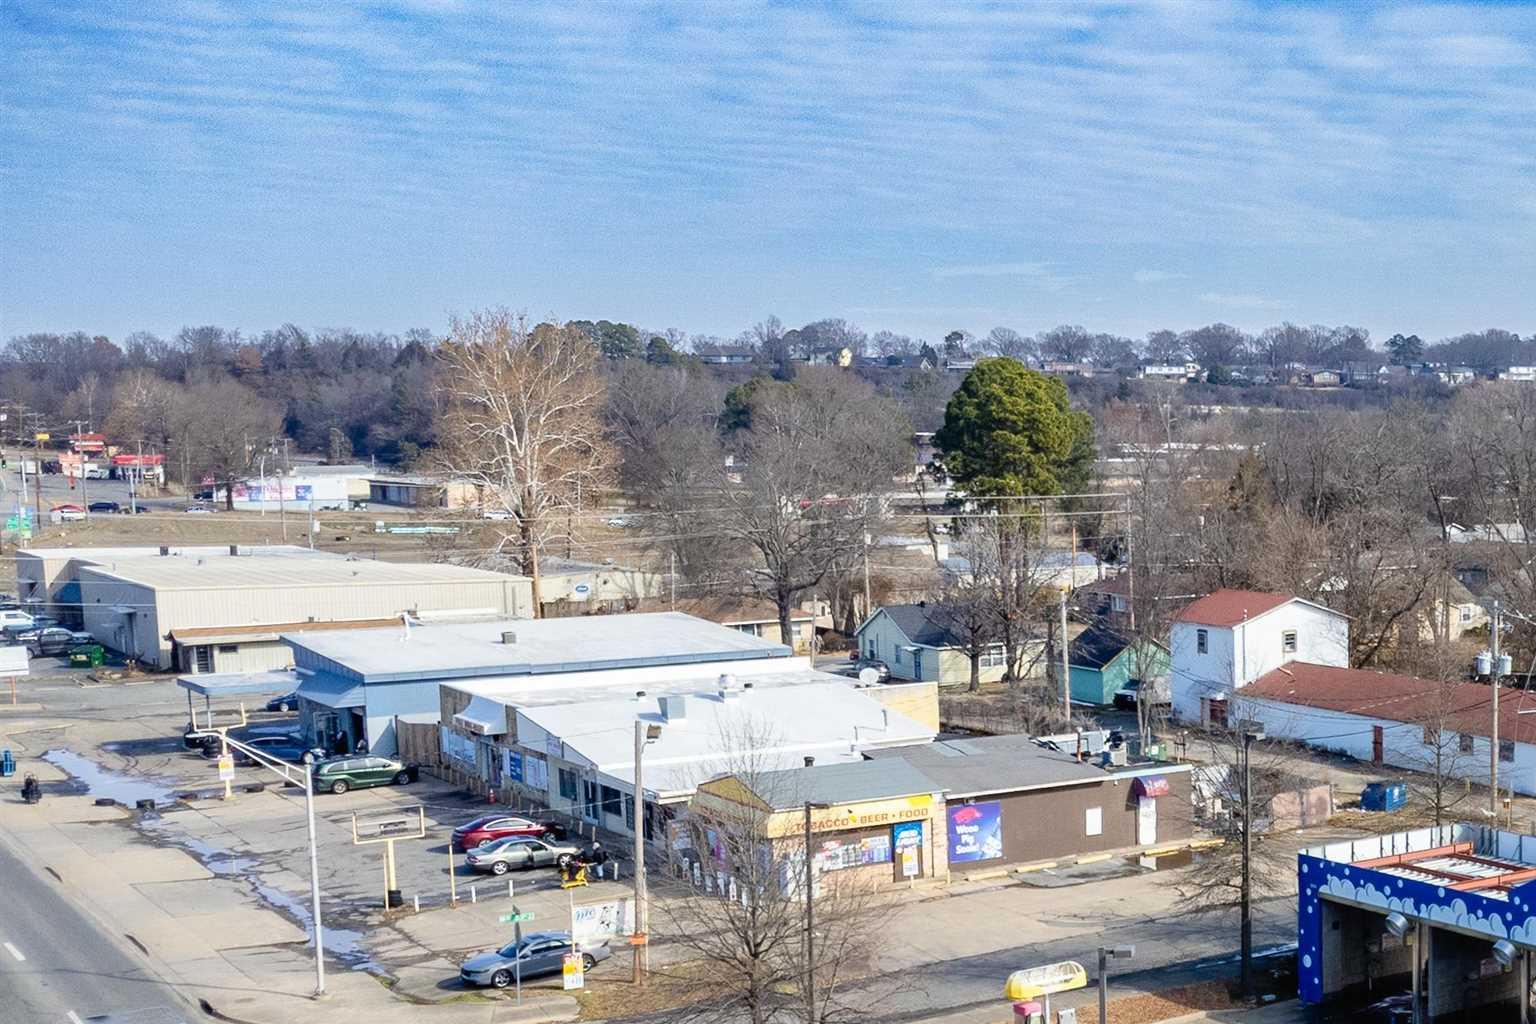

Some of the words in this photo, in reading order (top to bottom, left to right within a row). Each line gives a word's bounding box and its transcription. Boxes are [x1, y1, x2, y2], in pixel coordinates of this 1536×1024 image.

[796, 818, 849, 832] TOBACCO
[860, 813, 888, 824] BEER
[900, 808, 928, 818] FOOD
